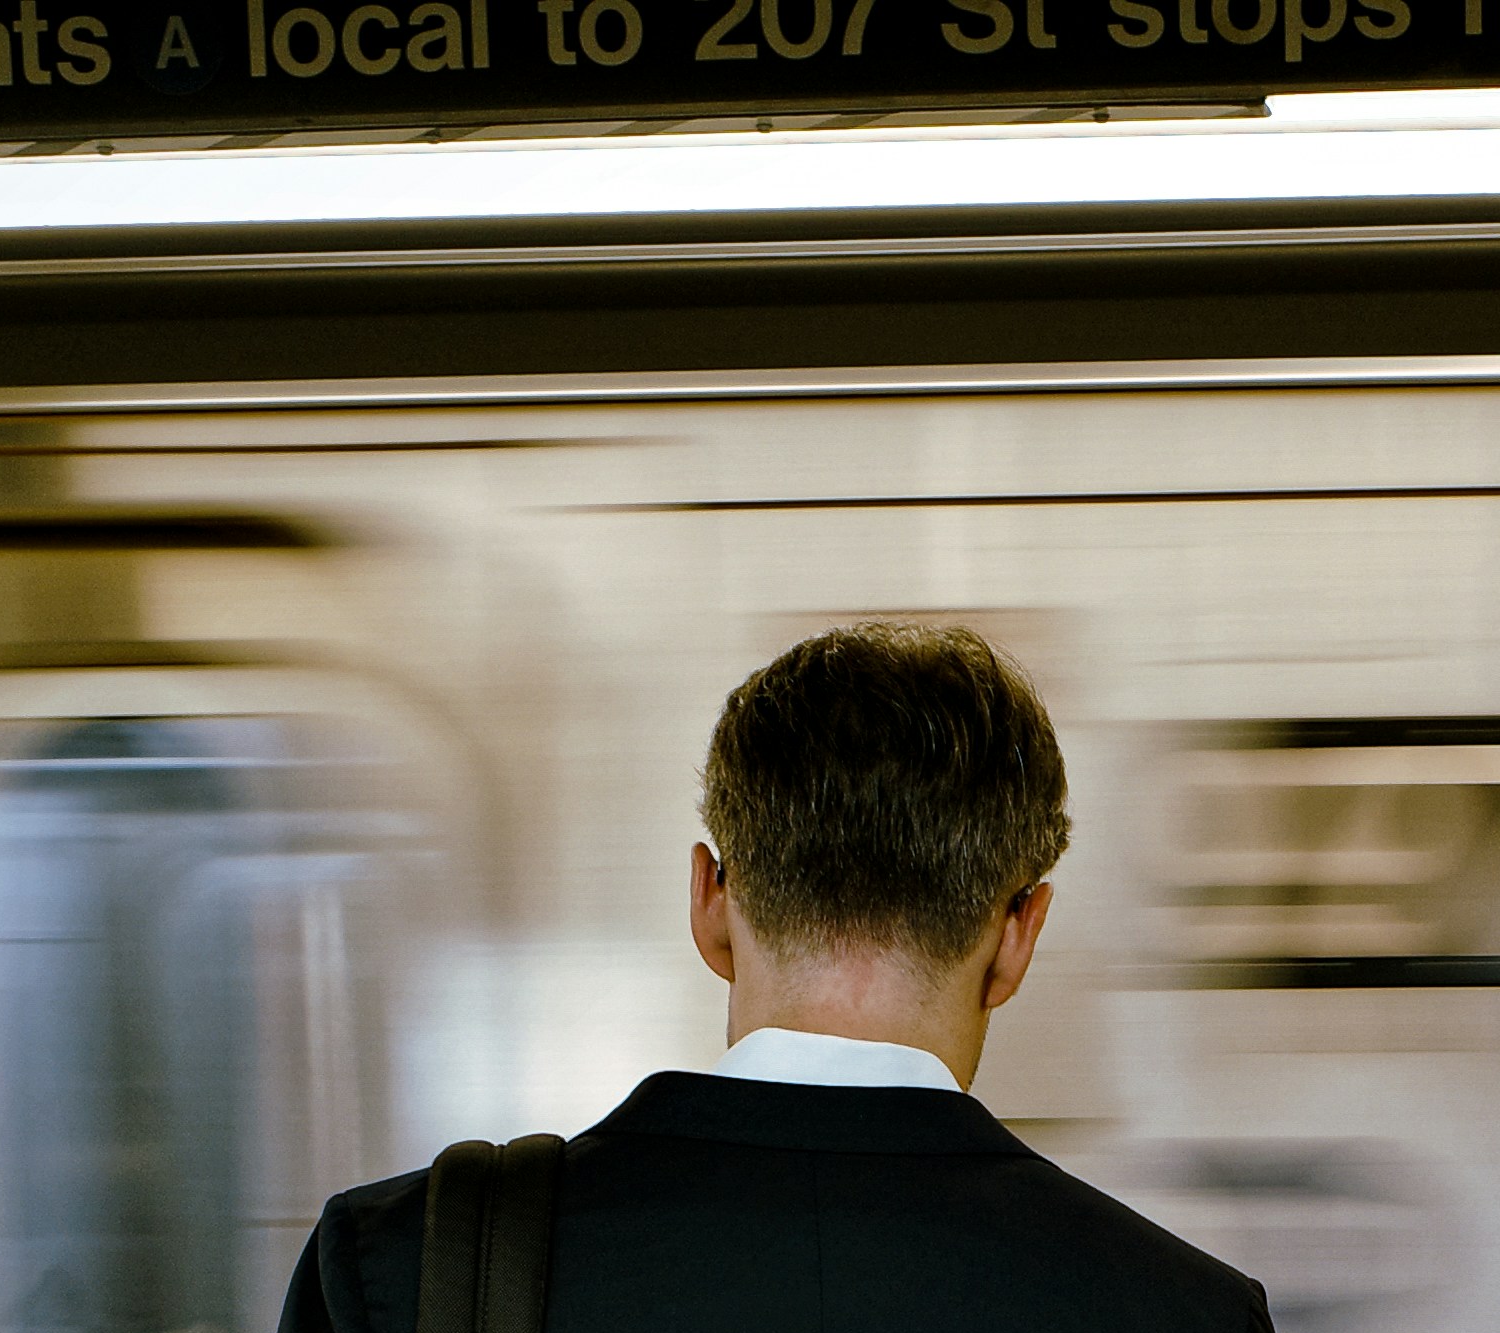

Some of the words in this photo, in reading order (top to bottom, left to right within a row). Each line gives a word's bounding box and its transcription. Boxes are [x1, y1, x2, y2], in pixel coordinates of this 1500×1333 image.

[155, 15, 200, 70] A
[245, 0, 491, 78] local
[537, 0, 644, 66] to
[694, 0, 877, 61] 207
